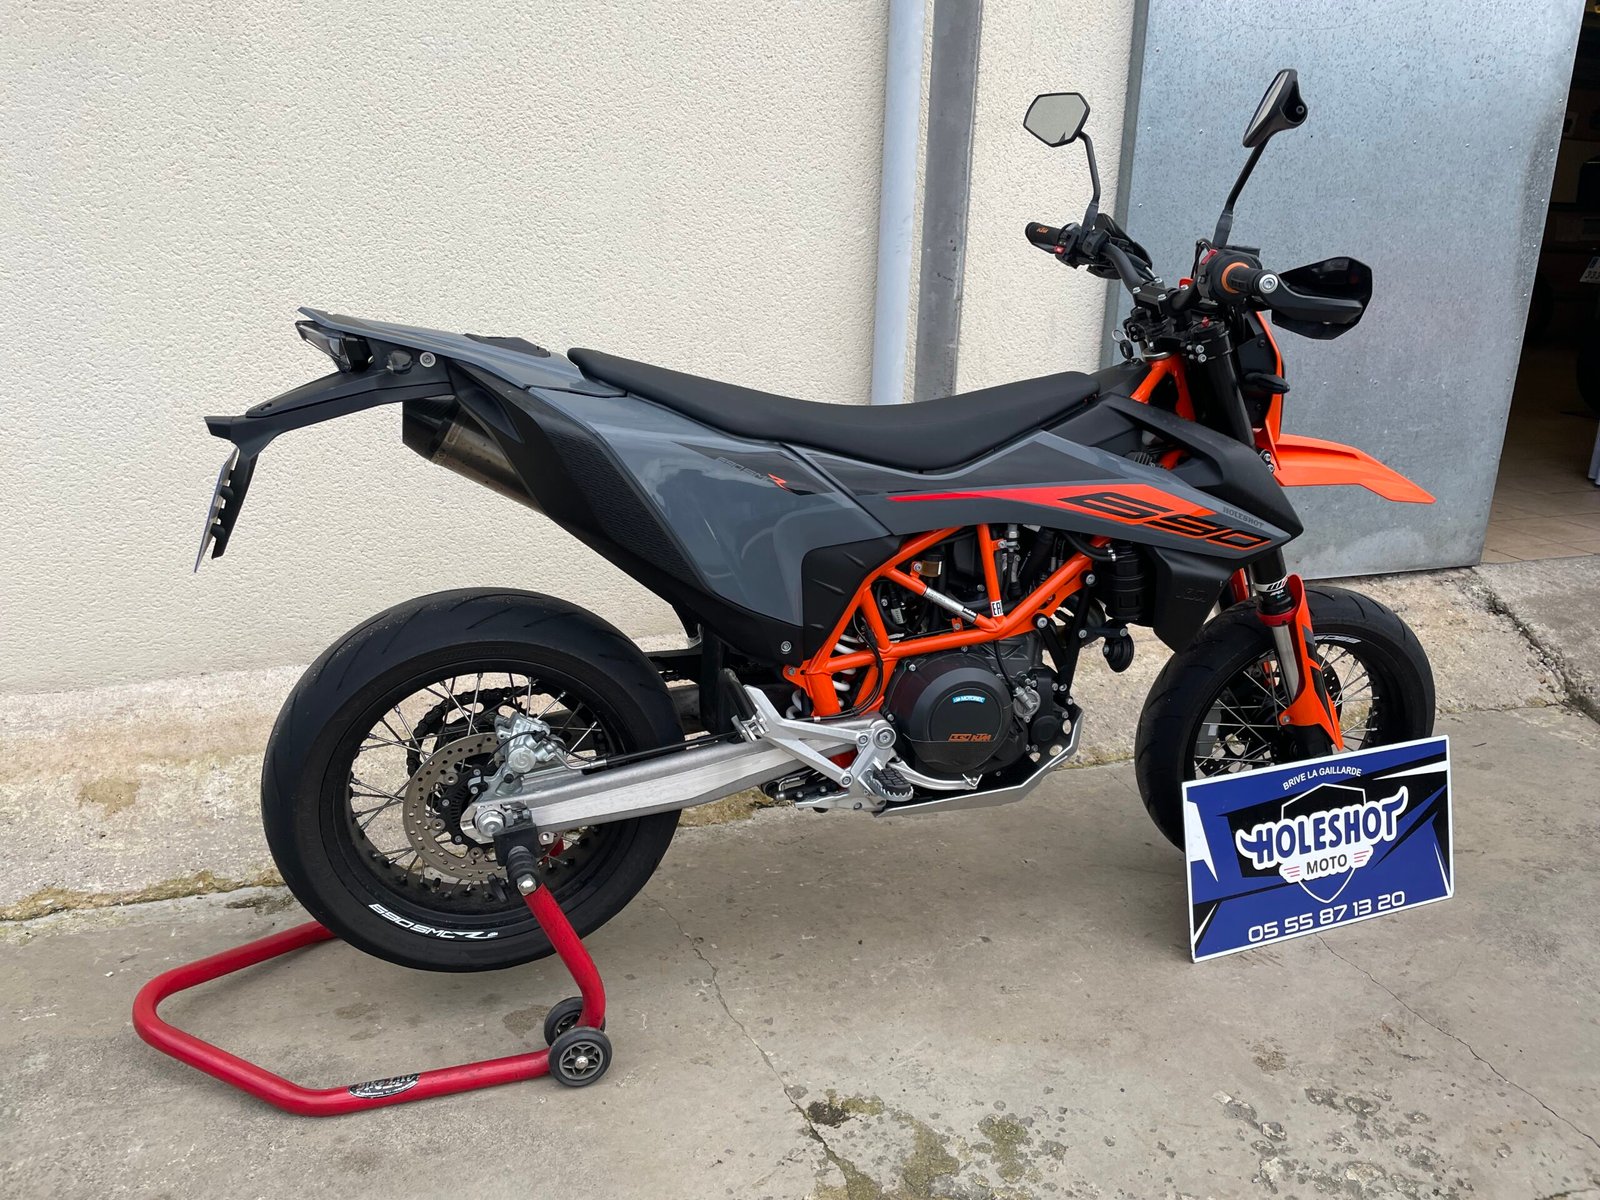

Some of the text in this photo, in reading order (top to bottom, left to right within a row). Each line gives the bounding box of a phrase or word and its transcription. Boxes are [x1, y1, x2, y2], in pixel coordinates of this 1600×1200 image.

[1222, 505, 1265, 529] HOLESHOT
[1282, 765, 1362, 791] BRIVE LA GAILLARDE
[1239, 790, 1406, 865] HOLESHOT
[1306, 853, 1348, 875] MOTO
[1248, 890, 1405, 942] 05 55 87 13 20
